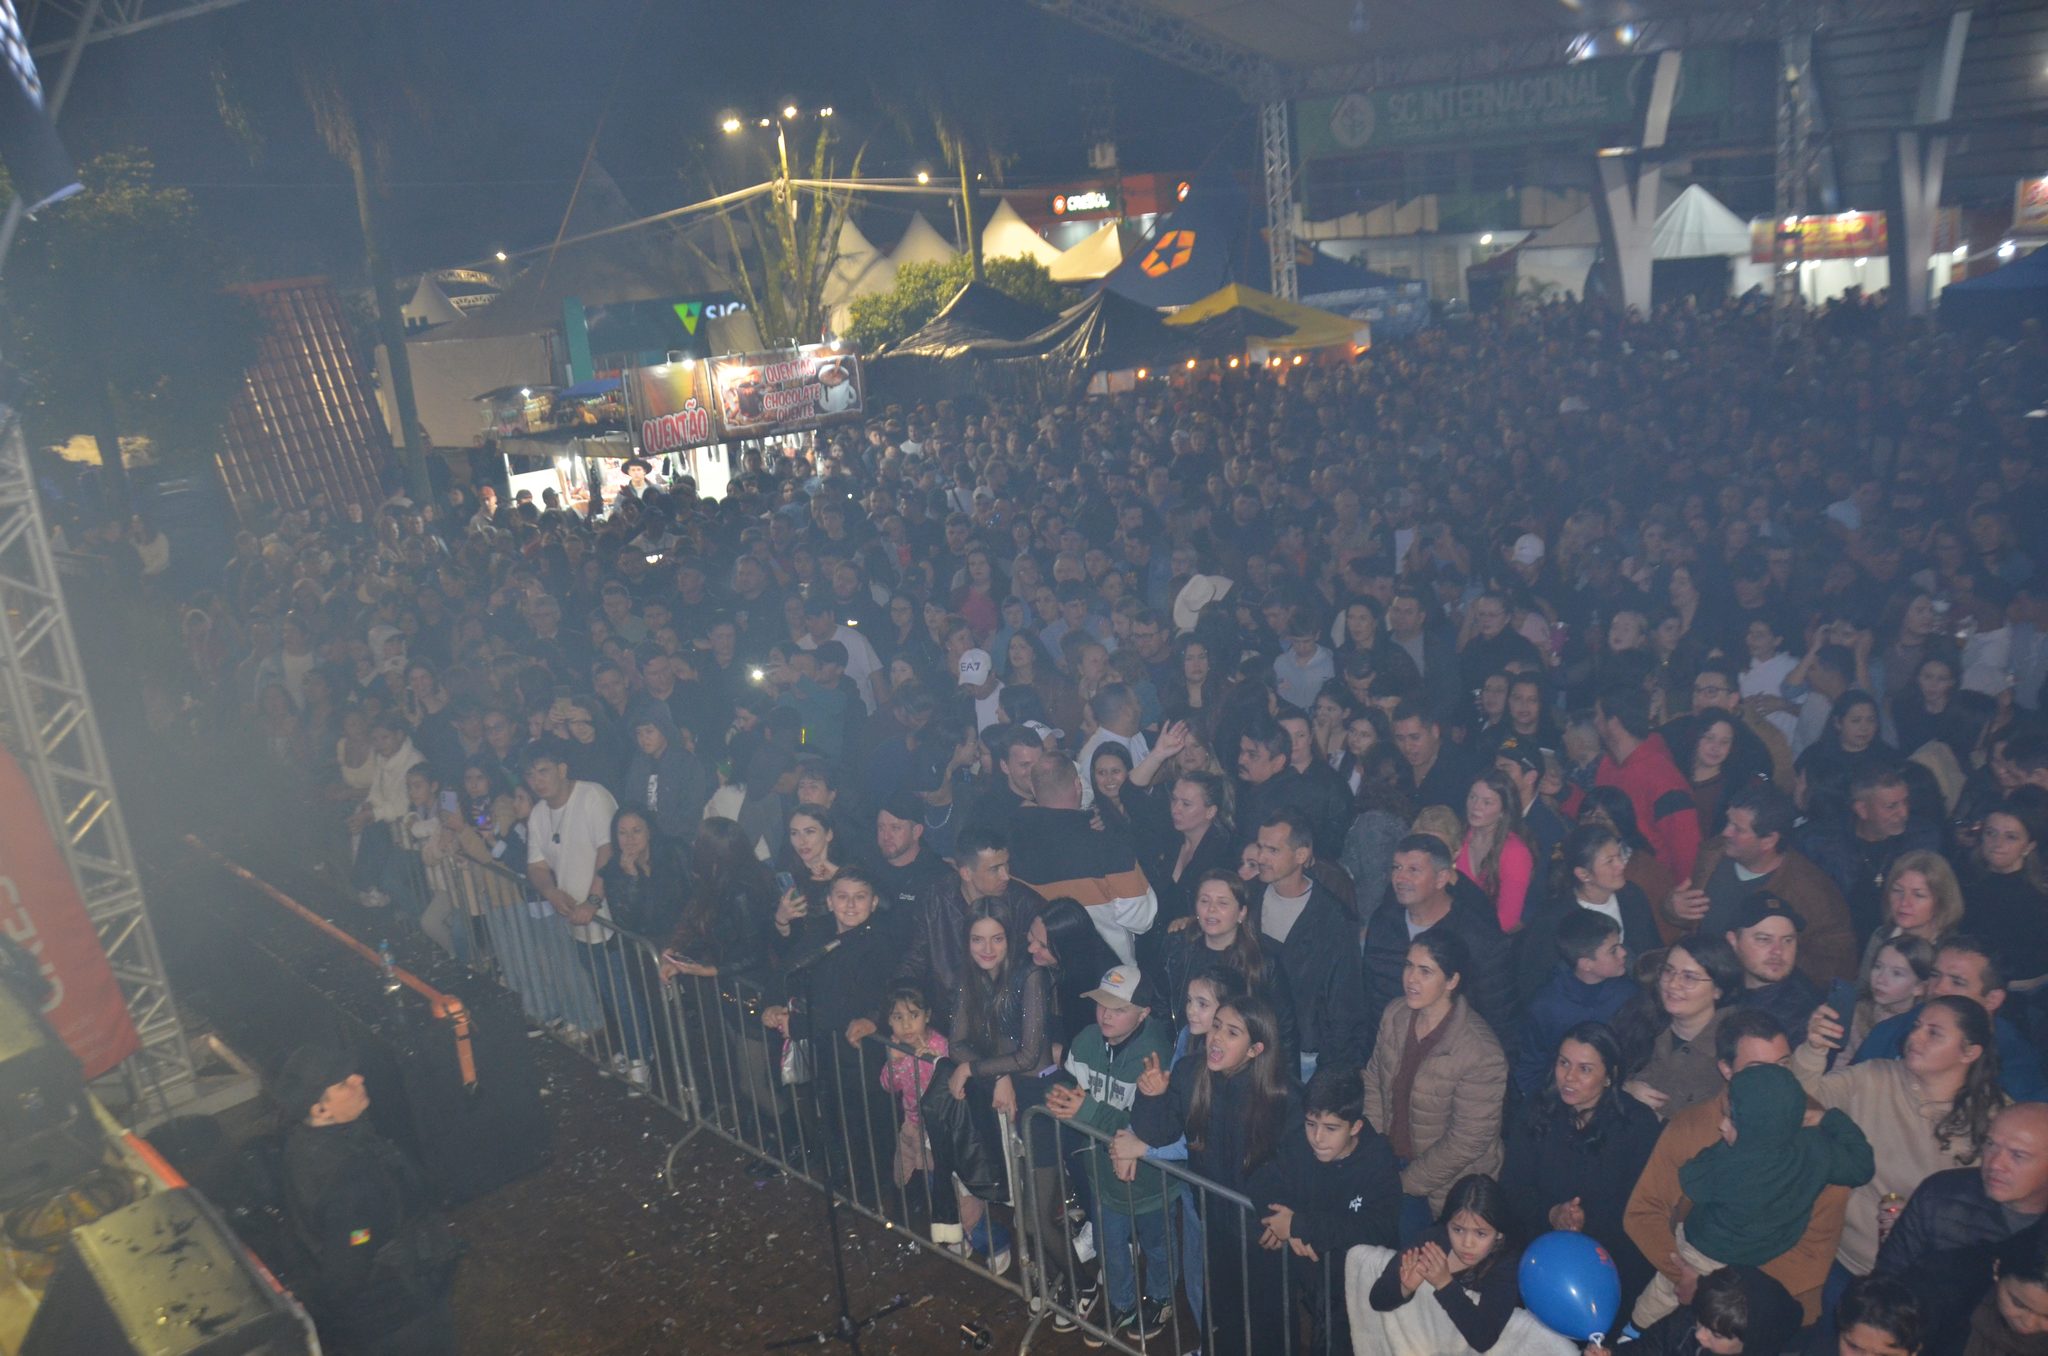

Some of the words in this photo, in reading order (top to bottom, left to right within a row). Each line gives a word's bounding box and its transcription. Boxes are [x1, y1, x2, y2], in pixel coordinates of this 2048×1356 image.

[1422, 69, 1608, 121] INTERNACIONAL
[763, 382, 822, 410] CHOCOLATE
[642, 398, 709, 453] QUENTÃO
[777, 402, 815, 424] QUENTE
[960, 662, 981, 672] EA7
